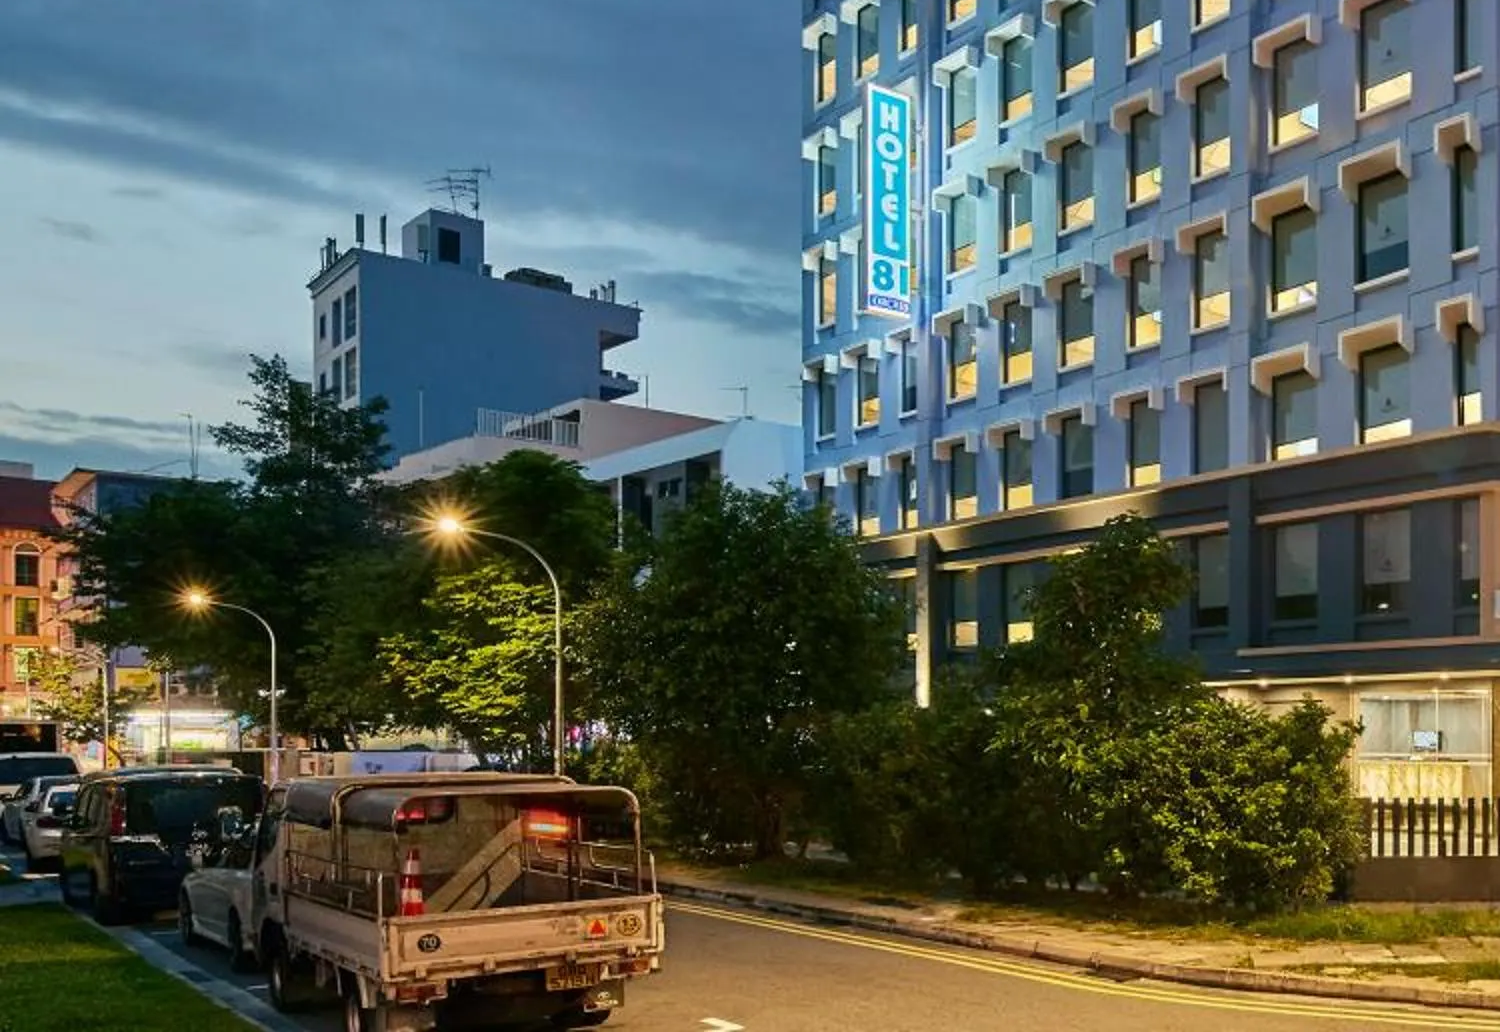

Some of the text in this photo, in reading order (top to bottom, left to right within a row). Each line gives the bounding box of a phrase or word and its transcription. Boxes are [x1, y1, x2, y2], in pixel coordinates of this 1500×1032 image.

[876, 102, 904, 251] HOTEL
[872, 259, 908, 296] 81
[421, 937, 438, 948] 70
